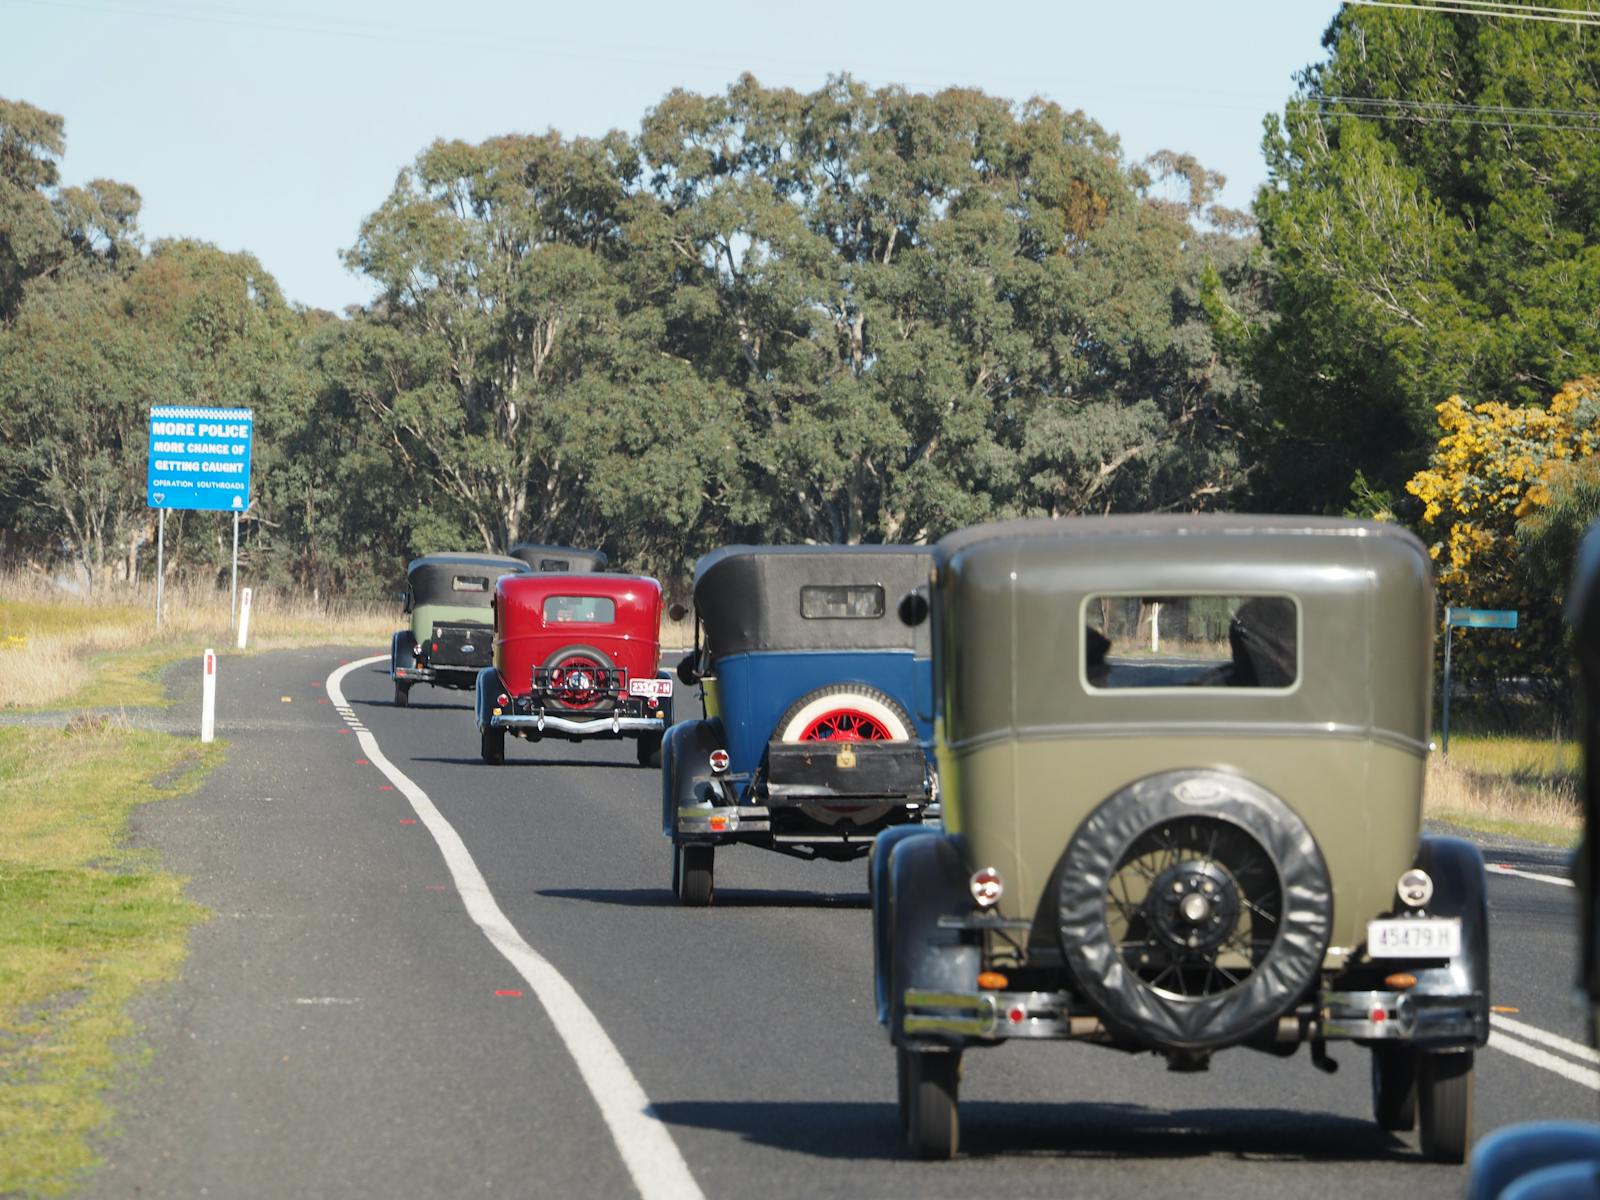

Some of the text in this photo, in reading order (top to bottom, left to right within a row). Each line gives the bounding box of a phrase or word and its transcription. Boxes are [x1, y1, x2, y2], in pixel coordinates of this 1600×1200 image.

[153, 422, 249, 438] MORE POLICE
[154, 442, 245, 455] MORE CHANCE OF
[154, 460, 244, 473] GETTING CAUGHT
[152, 479, 194, 488] OPERATION
